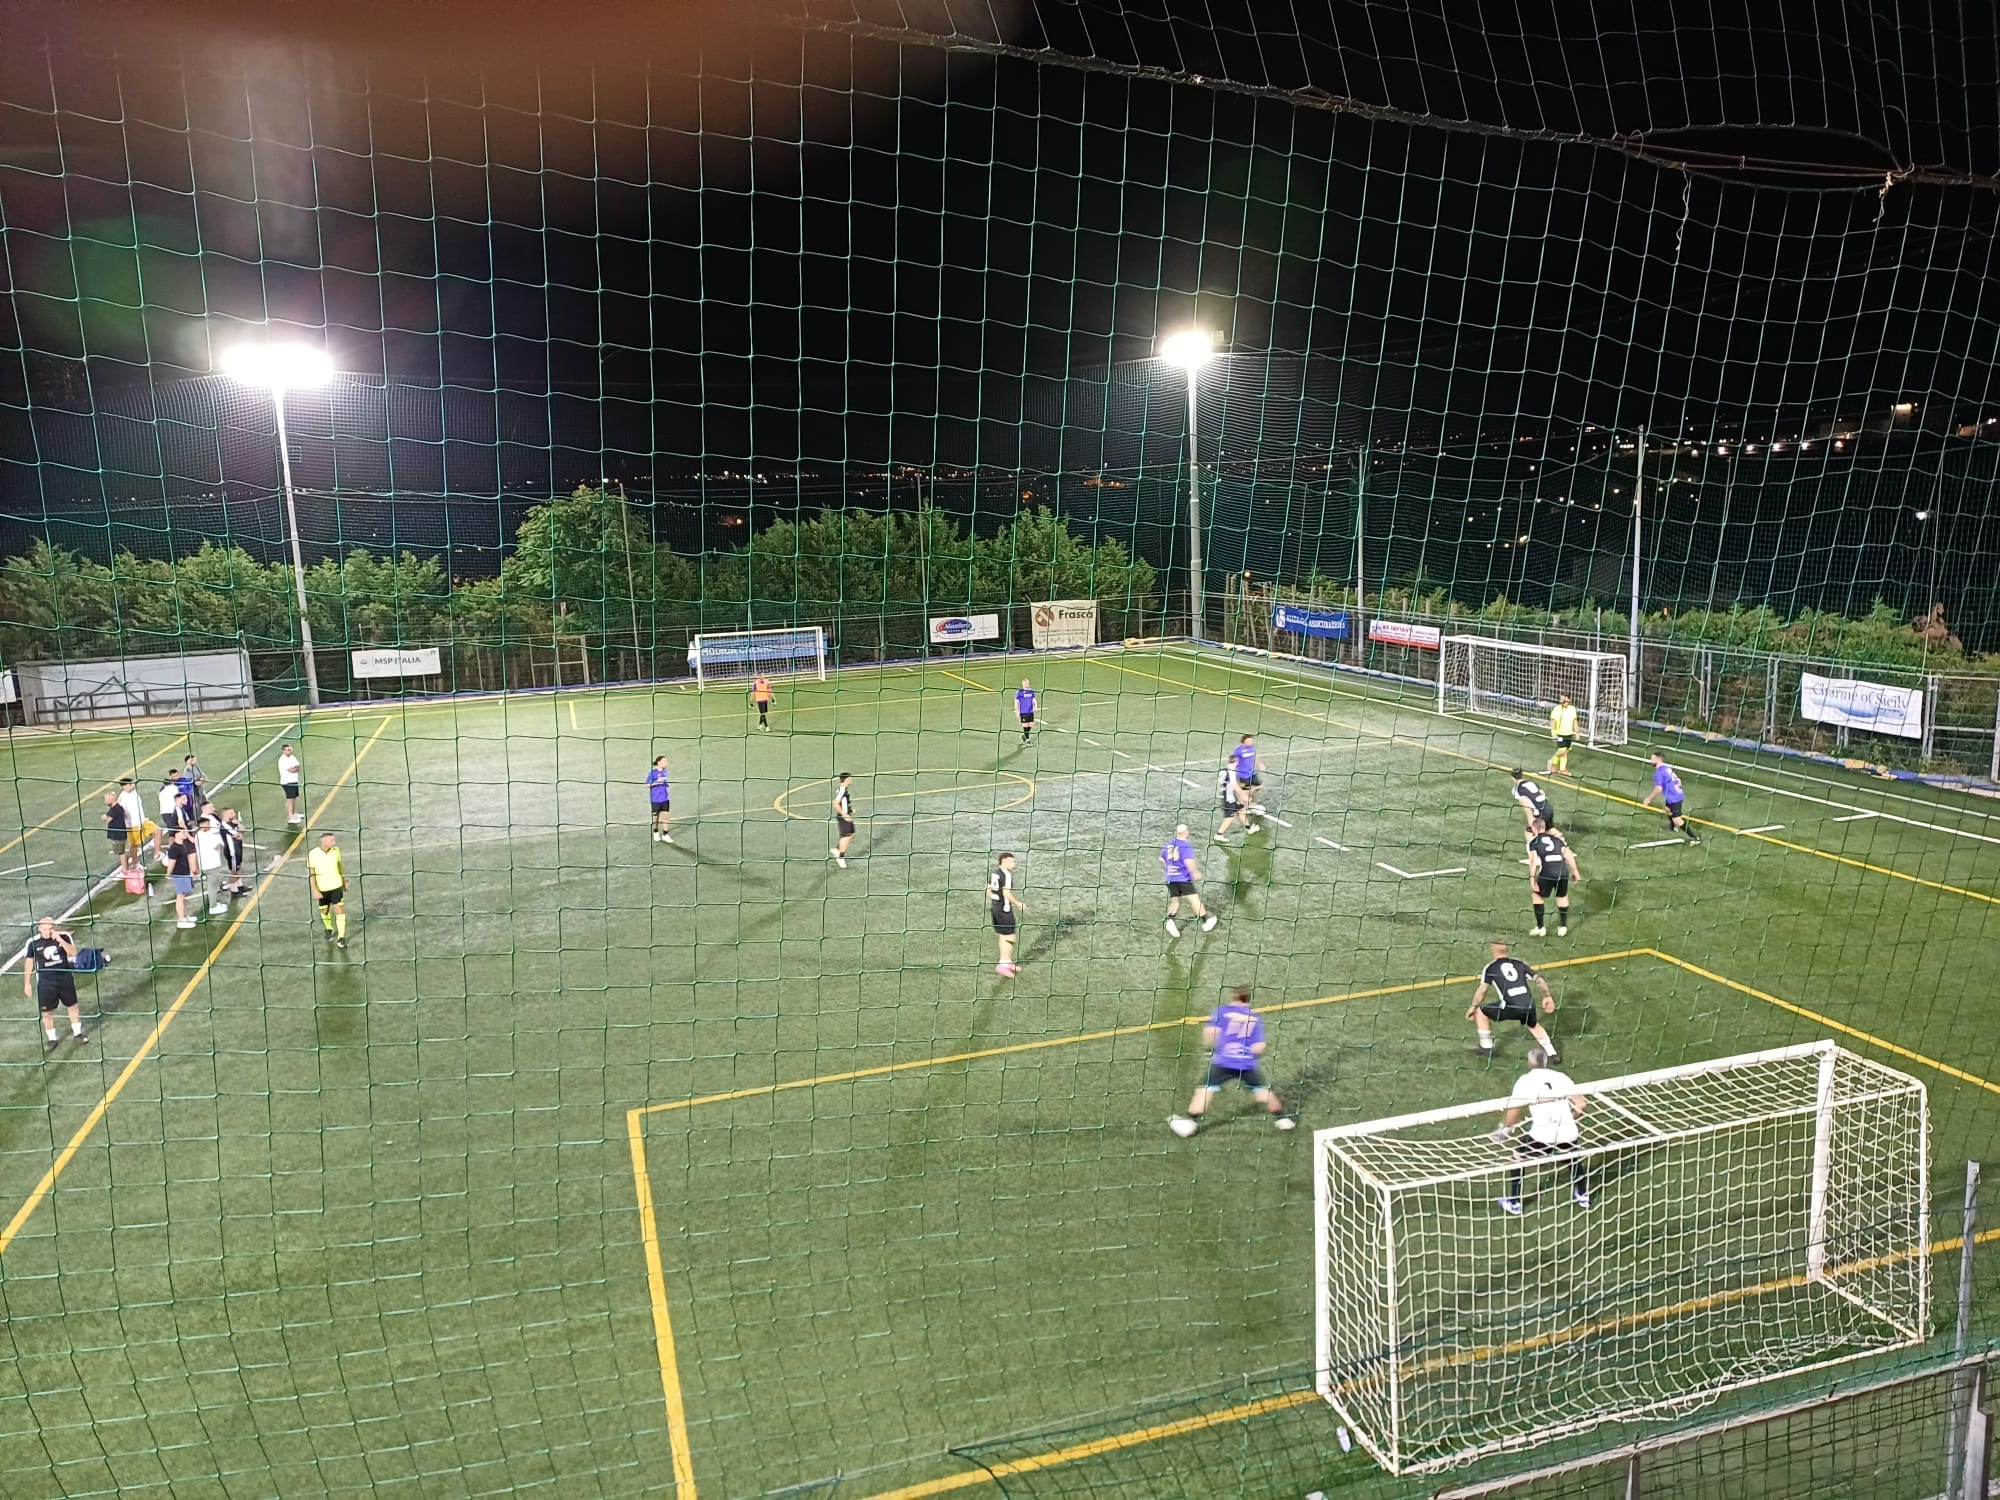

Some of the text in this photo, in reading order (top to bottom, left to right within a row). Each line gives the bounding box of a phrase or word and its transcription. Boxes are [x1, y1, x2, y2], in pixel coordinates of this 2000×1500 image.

[1059, 610, 1093, 619] Frasca
[1861, 691, 1874, 702] of
[1875, 692, 1908, 709] Sicily
[1500, 962, 1518, 982] 6
